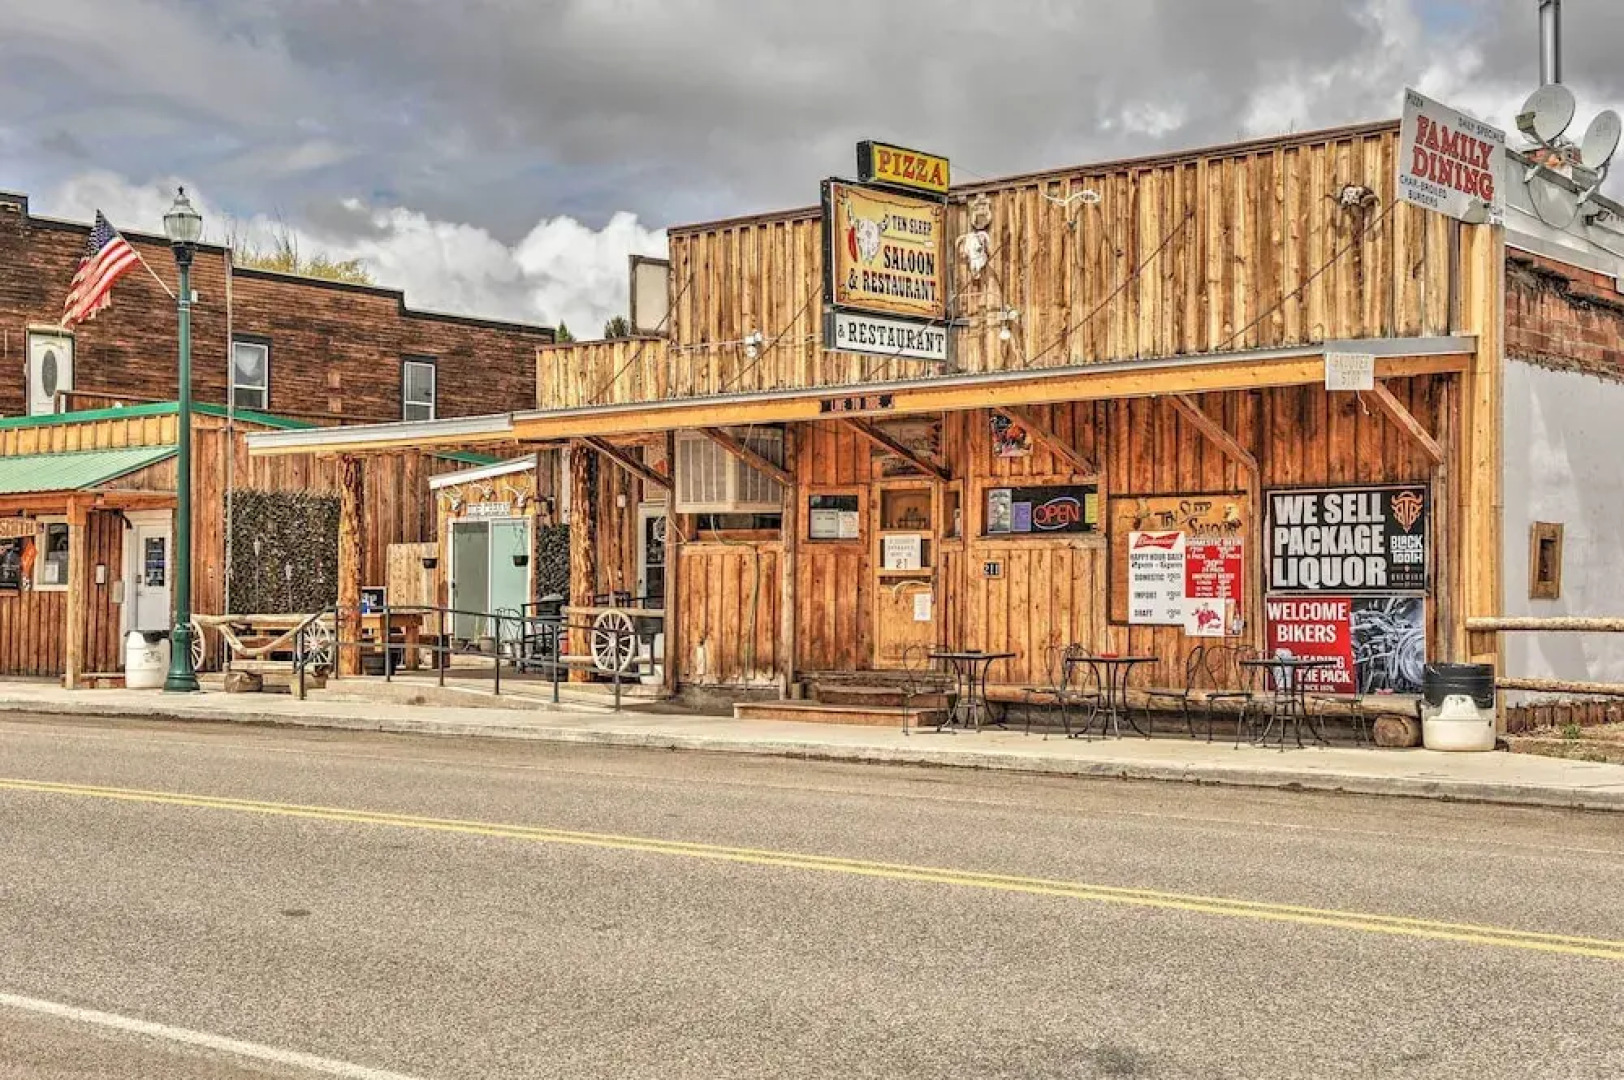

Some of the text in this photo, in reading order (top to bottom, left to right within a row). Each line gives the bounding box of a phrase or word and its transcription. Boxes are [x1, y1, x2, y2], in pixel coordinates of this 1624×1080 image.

[1415, 114, 1495, 171] FAMILY
[877, 149, 945, 186] PIZZA
[1411, 145, 1494, 202] DINING
[892, 215, 933, 236] TEN SLEEP
[883, 244, 935, 276] SALOON
[848, 267, 936, 301] & RESTAURANT
[838, 322, 944, 353] & RESTAURANT
[1034, 504, 1080, 524] OPEN
[1274, 493, 1386, 525] WE SELL
[1274, 524, 1385, 556] PACKAGE
[1390, 534, 1423, 549] BLACK
[1390, 549, 1423, 563] TOOTH
[1272, 556, 1388, 589] LIQUOR
[1267, 602, 1347, 621] WELCOME
[1277, 624, 1337, 643] BIKERS
[1321, 669, 1351, 682] PACK
